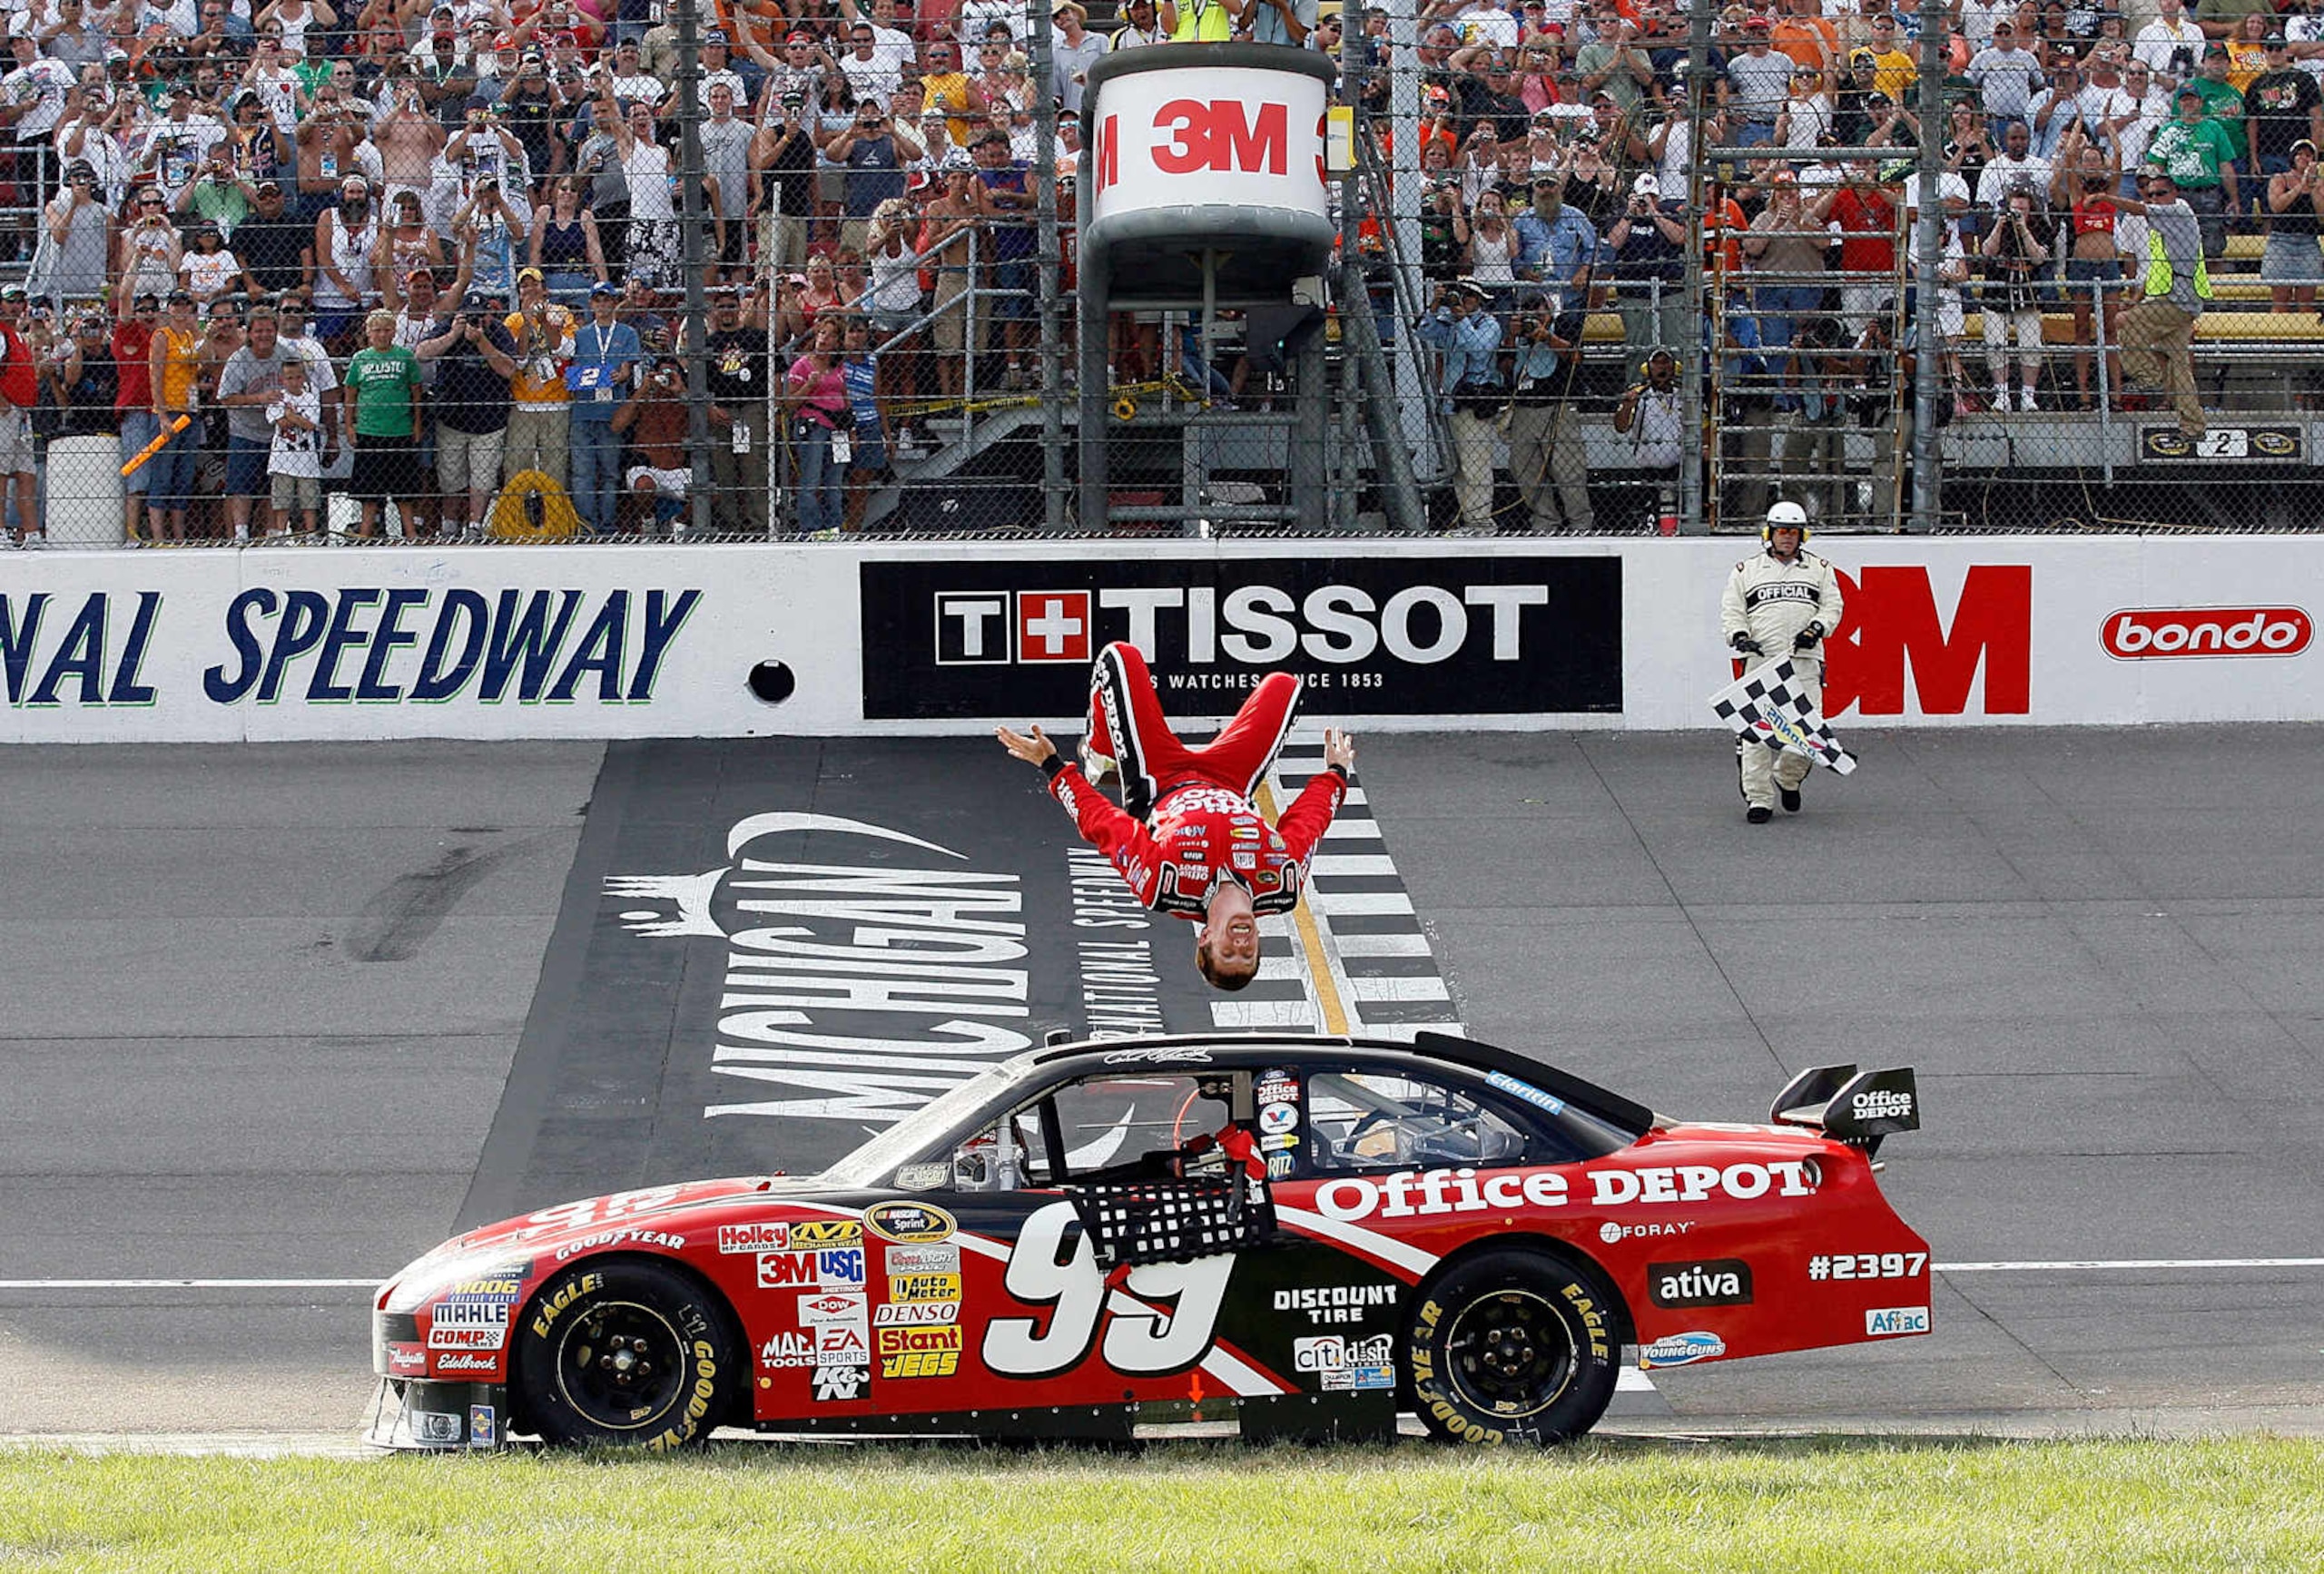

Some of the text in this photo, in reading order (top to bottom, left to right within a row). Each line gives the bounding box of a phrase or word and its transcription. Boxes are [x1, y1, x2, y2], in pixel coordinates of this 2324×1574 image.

[1150, 99, 1287, 175] 3M
[2215, 432, 2230, 454] 2
[1758, 585, 1811, 600] OFFICIAL
[1099, 585, 1548, 664] TISSOT
[2114, 614, 2297, 652] bondo
[203, 587, 703, 705] SPEEDWAY
[1169, 674, 1260, 689] WATCHES
[1294, 674, 1330, 689] NCE
[1341, 673, 1383, 687] 1853
[1104, 687, 1128, 759] DEPOT
[704, 858, 1032, 1122] MICHIGAN
[1258, 1084, 1299, 1096] Office
[1258, 1093, 1299, 1105] DEPOT
[1489, 1073, 1561, 1110] Claritin
[1852, 1090, 1912, 1108] Office
[1853, 1104, 1912, 1120] DEPOT
[1268, 1156, 1293, 1179] RITZ
[1315, 1161, 1808, 1222] Office DEPOT
[721, 1225, 787, 1248] Holley
[894, 1219, 925, 1231] Sprint
[1621, 1222, 1691, 1237] FORAY
[556, 1227, 685, 1262] GOODYEAR
[761, 1252, 817, 1284] 3M
[821, 1249, 863, 1283] USG
[1808, 1251, 1928, 1281] #2397
[455, 1280, 521, 1294] MOOG
[908, 1287, 957, 1300] Meter
[911, 1276, 948, 1288] Auto
[981, 1199, 1237, 1373] 99
[1659, 1265, 1740, 1299] ativa
[532, 1273, 596, 1340] EAGLE
[818, 1301, 850, 1311] DOW
[1274, 1284, 1396, 1310] DISCOUNT
[434, 1303, 507, 1323] MAHLE
[876, 1304, 957, 1323] DENSO
[1307, 1307, 1364, 1323] TIRE
[1561, 1282, 1610, 1365] EAGLE
[431, 1331, 486, 1344] COMP
[762, 1331, 815, 1358] MAC
[821, 1327, 864, 1352] EA
[881, 1328, 960, 1352] Stant
[437, 1353, 497, 1370] Edelbrock
[819, 1351, 868, 1363] SPORTS
[1297, 1343, 1341, 1369] citi
[1344, 1338, 1391, 1363] dish
[761, 1358, 816, 1369] TOOLS
[883, 1353, 960, 1378] JEGS
